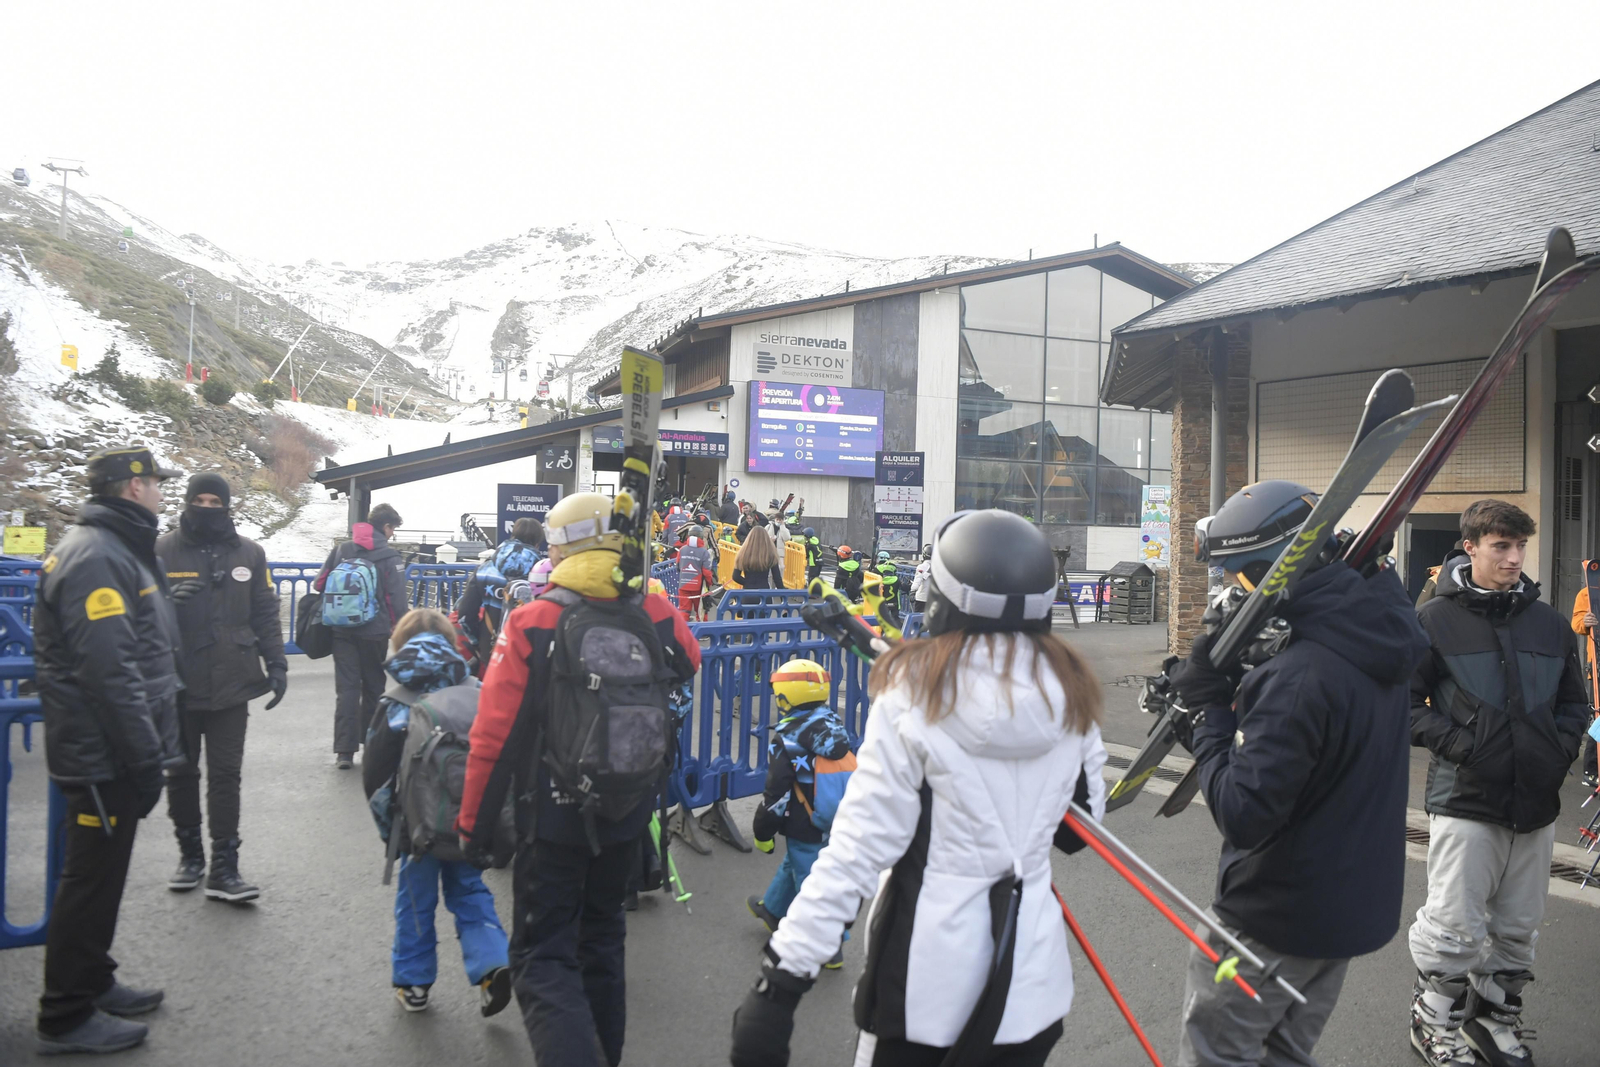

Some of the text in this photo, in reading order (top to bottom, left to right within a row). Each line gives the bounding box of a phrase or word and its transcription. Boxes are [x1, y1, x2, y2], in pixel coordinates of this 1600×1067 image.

[760, 331, 847, 350] sierranevada
[781, 353, 844, 369] DEKTON
[781, 369, 844, 380] designed by COSENTINO
[631, 372, 643, 430] REBELS
[761, 396, 804, 406] DE APERTURA
[506, 503, 516, 511] AL
